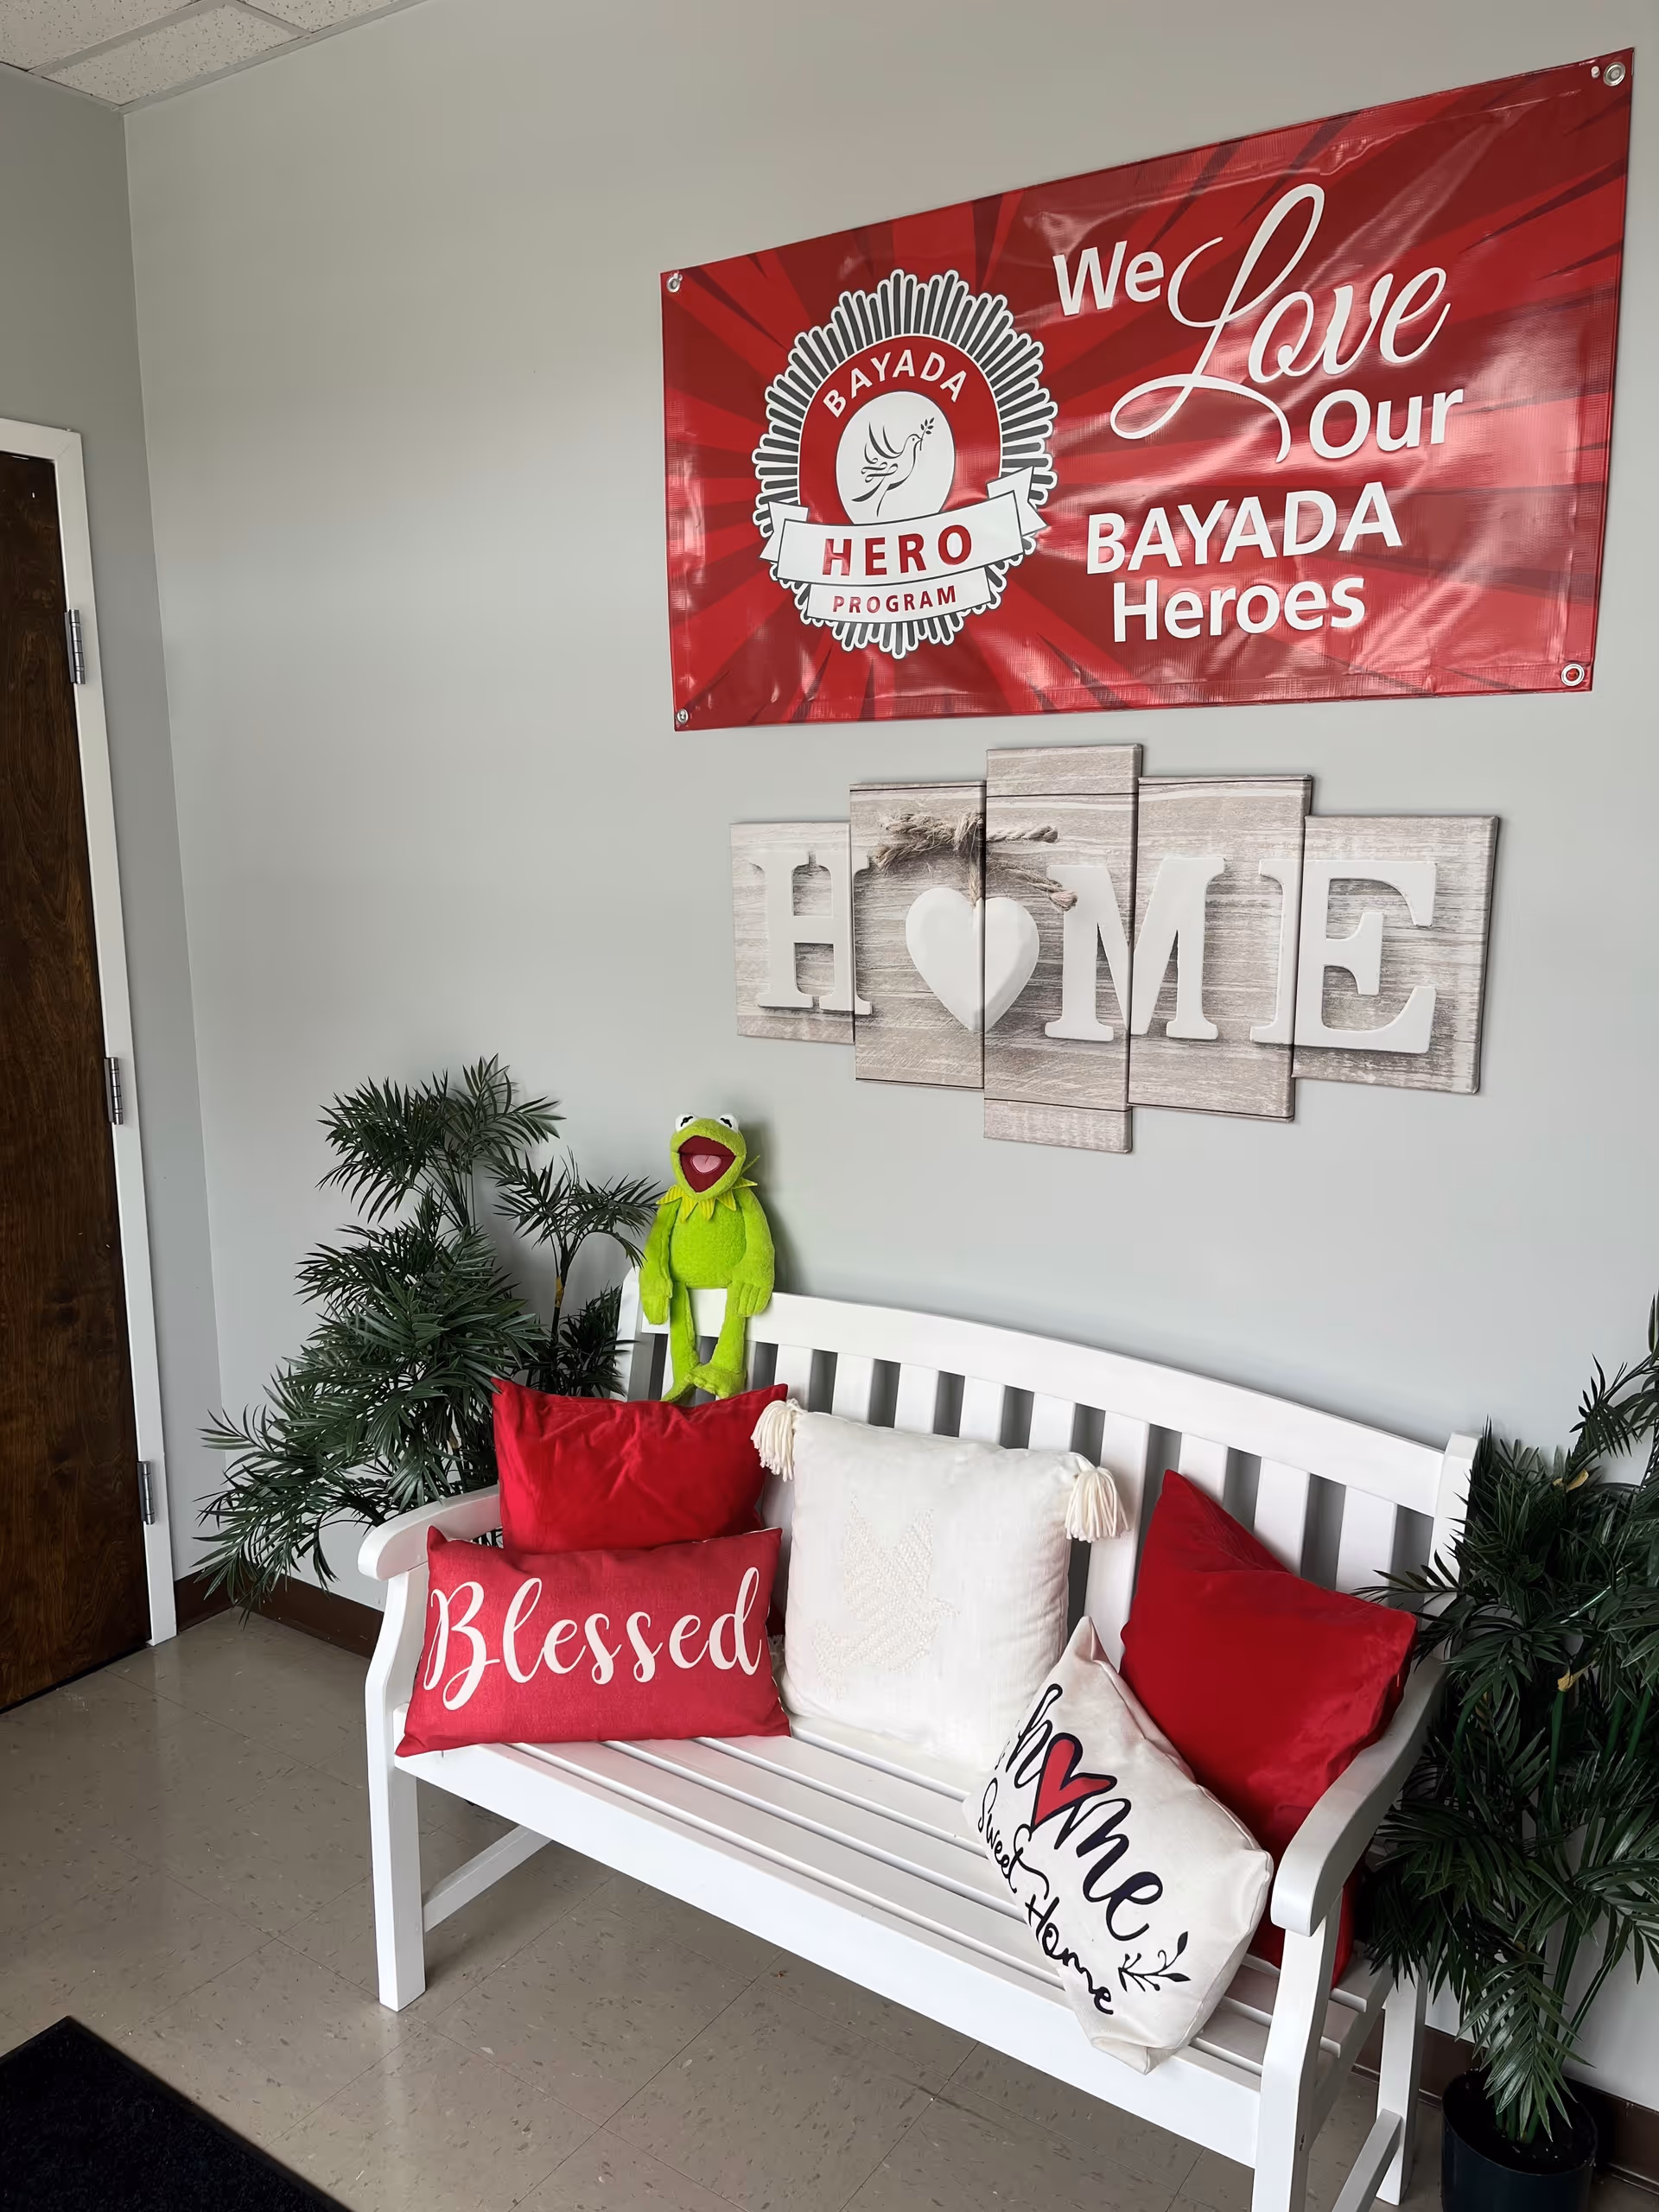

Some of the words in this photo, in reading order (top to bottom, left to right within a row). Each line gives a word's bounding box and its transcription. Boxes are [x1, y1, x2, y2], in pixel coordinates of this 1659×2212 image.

[1053, 241, 1164, 316] We
[1110, 183, 1451, 463] Love
[822, 349, 969, 418] BAYADA
[1309, 389, 1464, 461] Our
[822, 524, 974, 576] HERO
[1086, 481, 1403, 575] BAYADA
[832, 584, 958, 613] PROGRAM
[1113, 575, 1365, 642] Heroes
[423, 1567, 762, 1711] Blessed
[977, 1777, 1050, 1894] Sweet
[1025, 1896, 1114, 2016] Home
